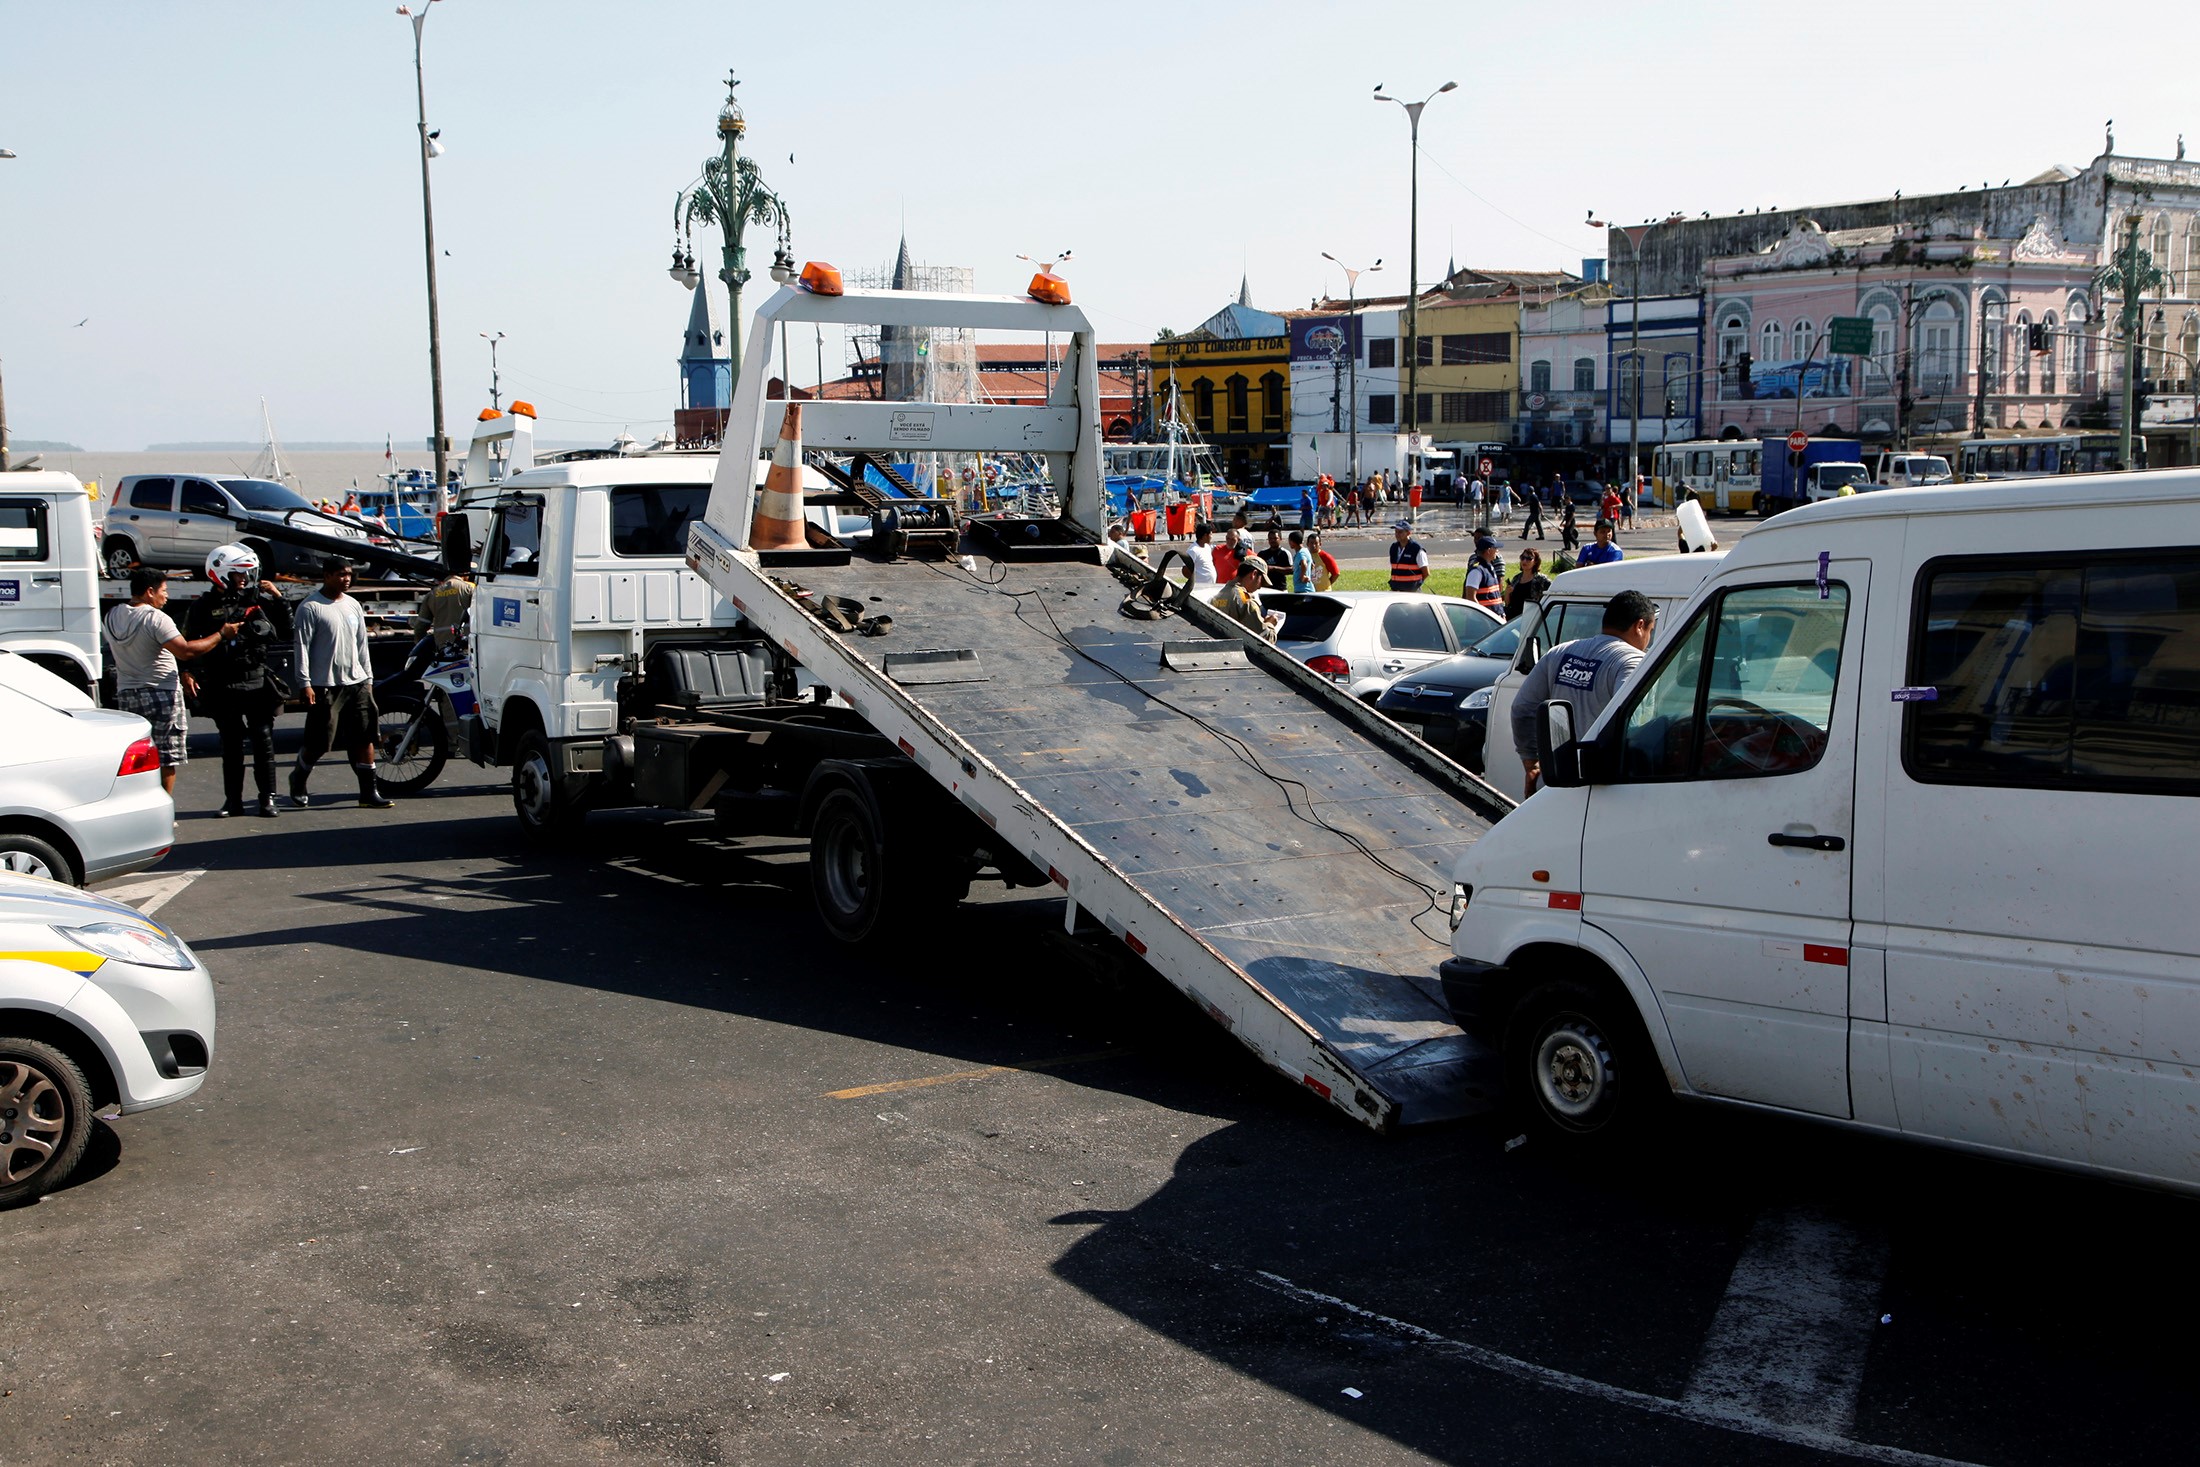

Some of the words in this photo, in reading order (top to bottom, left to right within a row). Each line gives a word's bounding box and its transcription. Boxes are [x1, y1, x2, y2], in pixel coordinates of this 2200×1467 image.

[1165, 344, 1180, 355] REI
[1186, 342, 1199, 354] DO
[1257, 338, 1284, 350] LTDA
[1790, 437, 1806, 445] PARE
